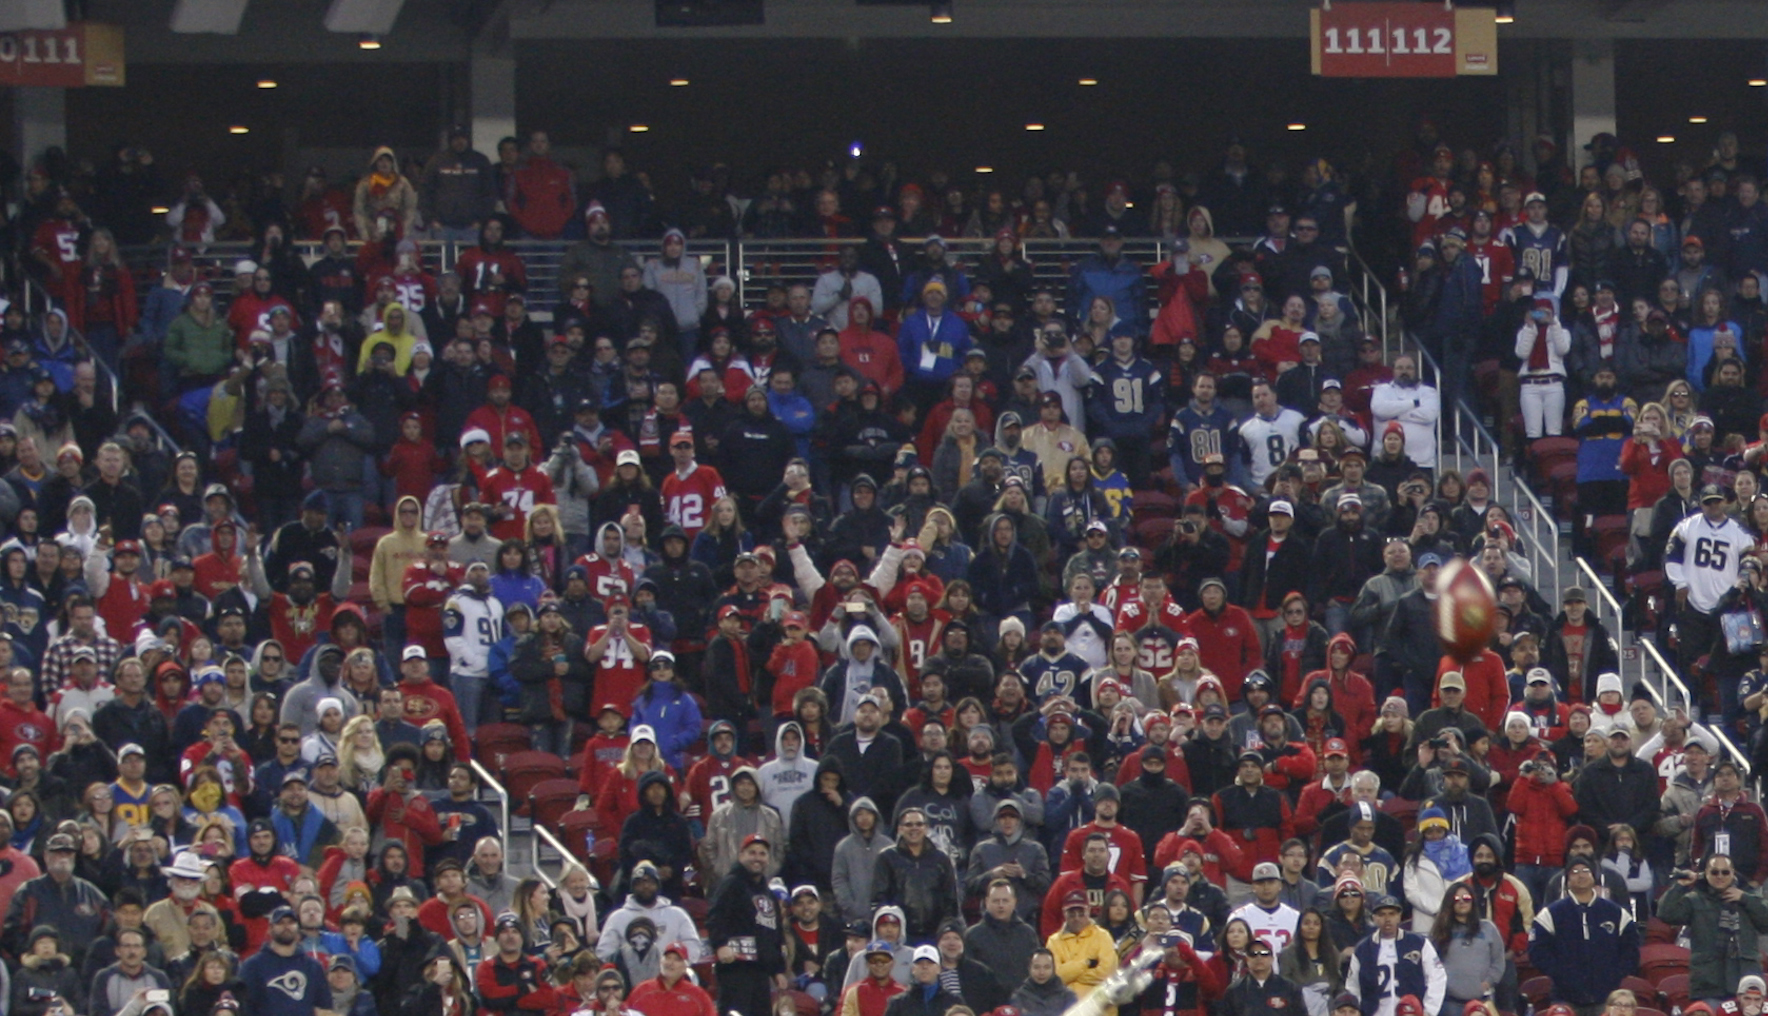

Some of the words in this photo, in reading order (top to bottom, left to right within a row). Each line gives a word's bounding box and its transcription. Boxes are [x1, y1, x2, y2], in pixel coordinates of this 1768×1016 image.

[24, 36, 81, 63] 111
[1325, 29, 1386, 54] 111
[1392, 29, 1451, 54] 112
[1112, 377, 1144, 414] 91
[1190, 429, 1221, 464] 81
[668, 494, 704, 528] 42
[1694, 537, 1730, 571] 65
[477, 617, 500, 647] 91
